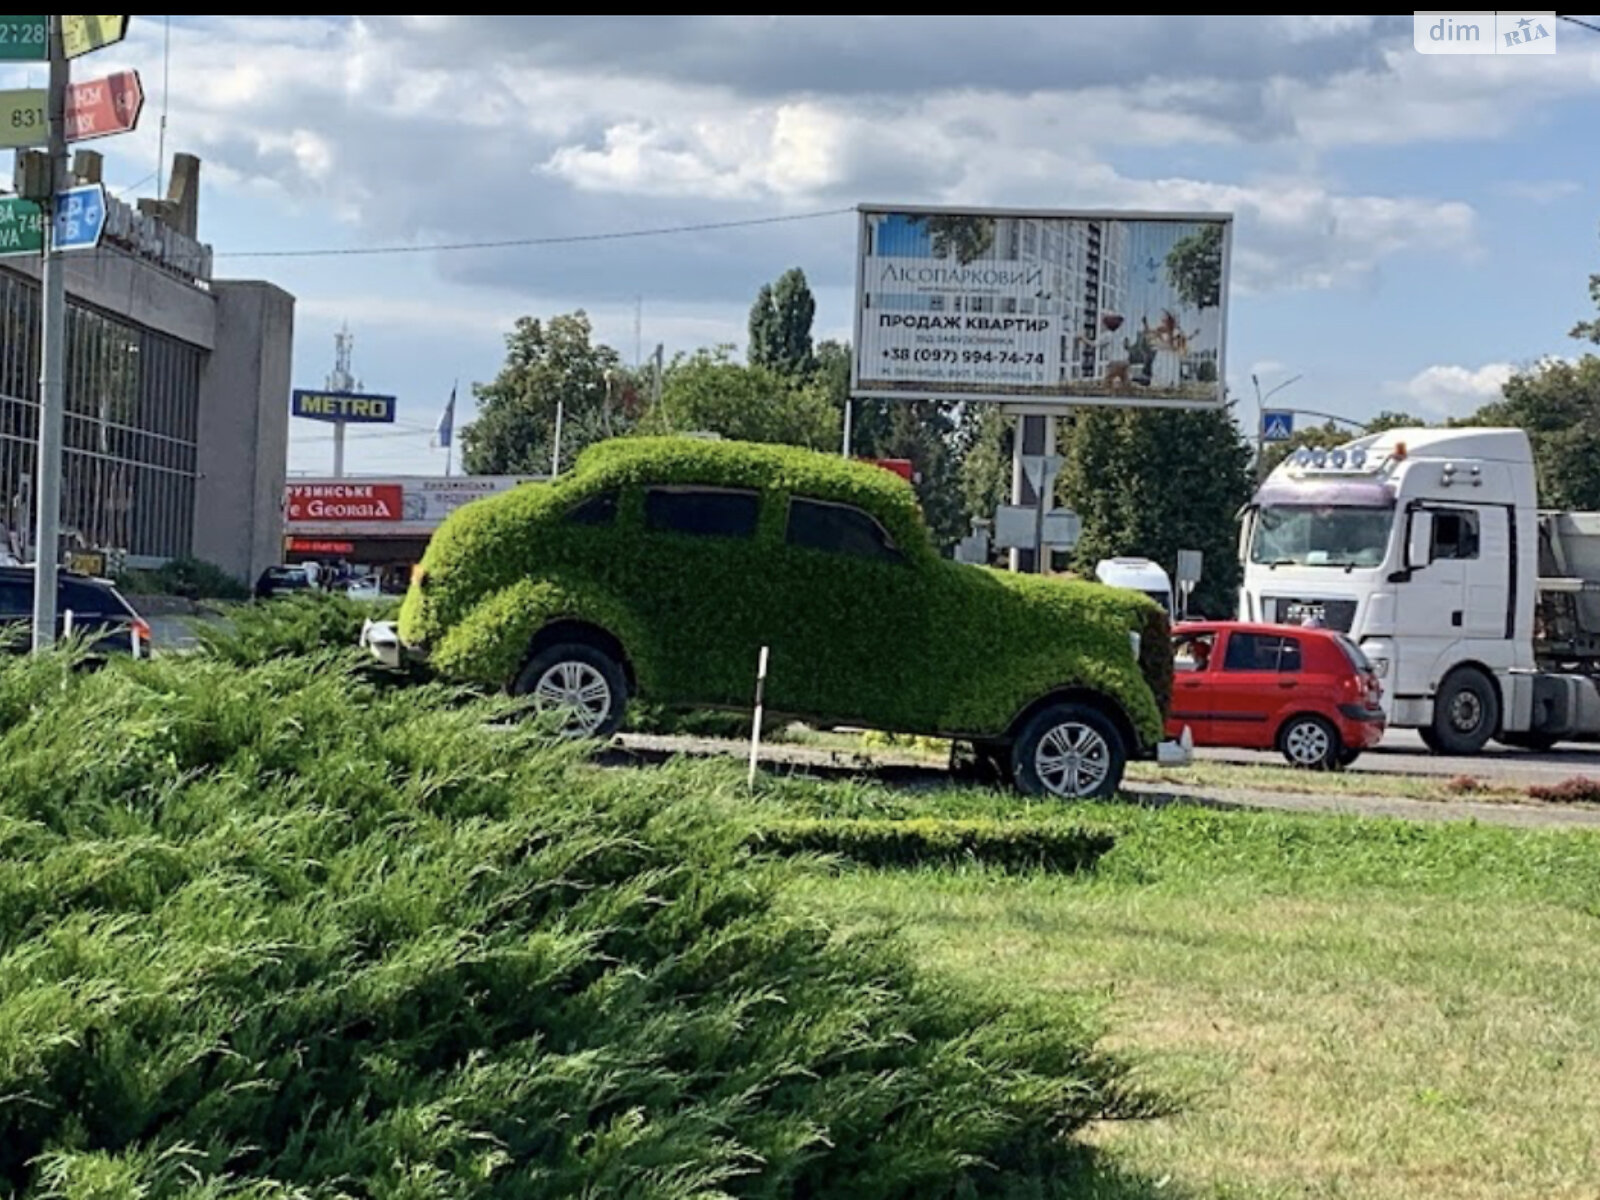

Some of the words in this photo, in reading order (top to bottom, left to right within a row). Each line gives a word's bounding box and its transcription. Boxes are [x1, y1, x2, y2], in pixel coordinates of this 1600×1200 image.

[880, 314, 961, 330] ПРОДАЖ
[966, 317, 1049, 332] КВАРТИР
[882, 349, 909, 361] +38
[914, 350, 957, 364] (097)
[963, 351, 1044, 365] 994-74-74
[300, 395, 386, 417] METRO
